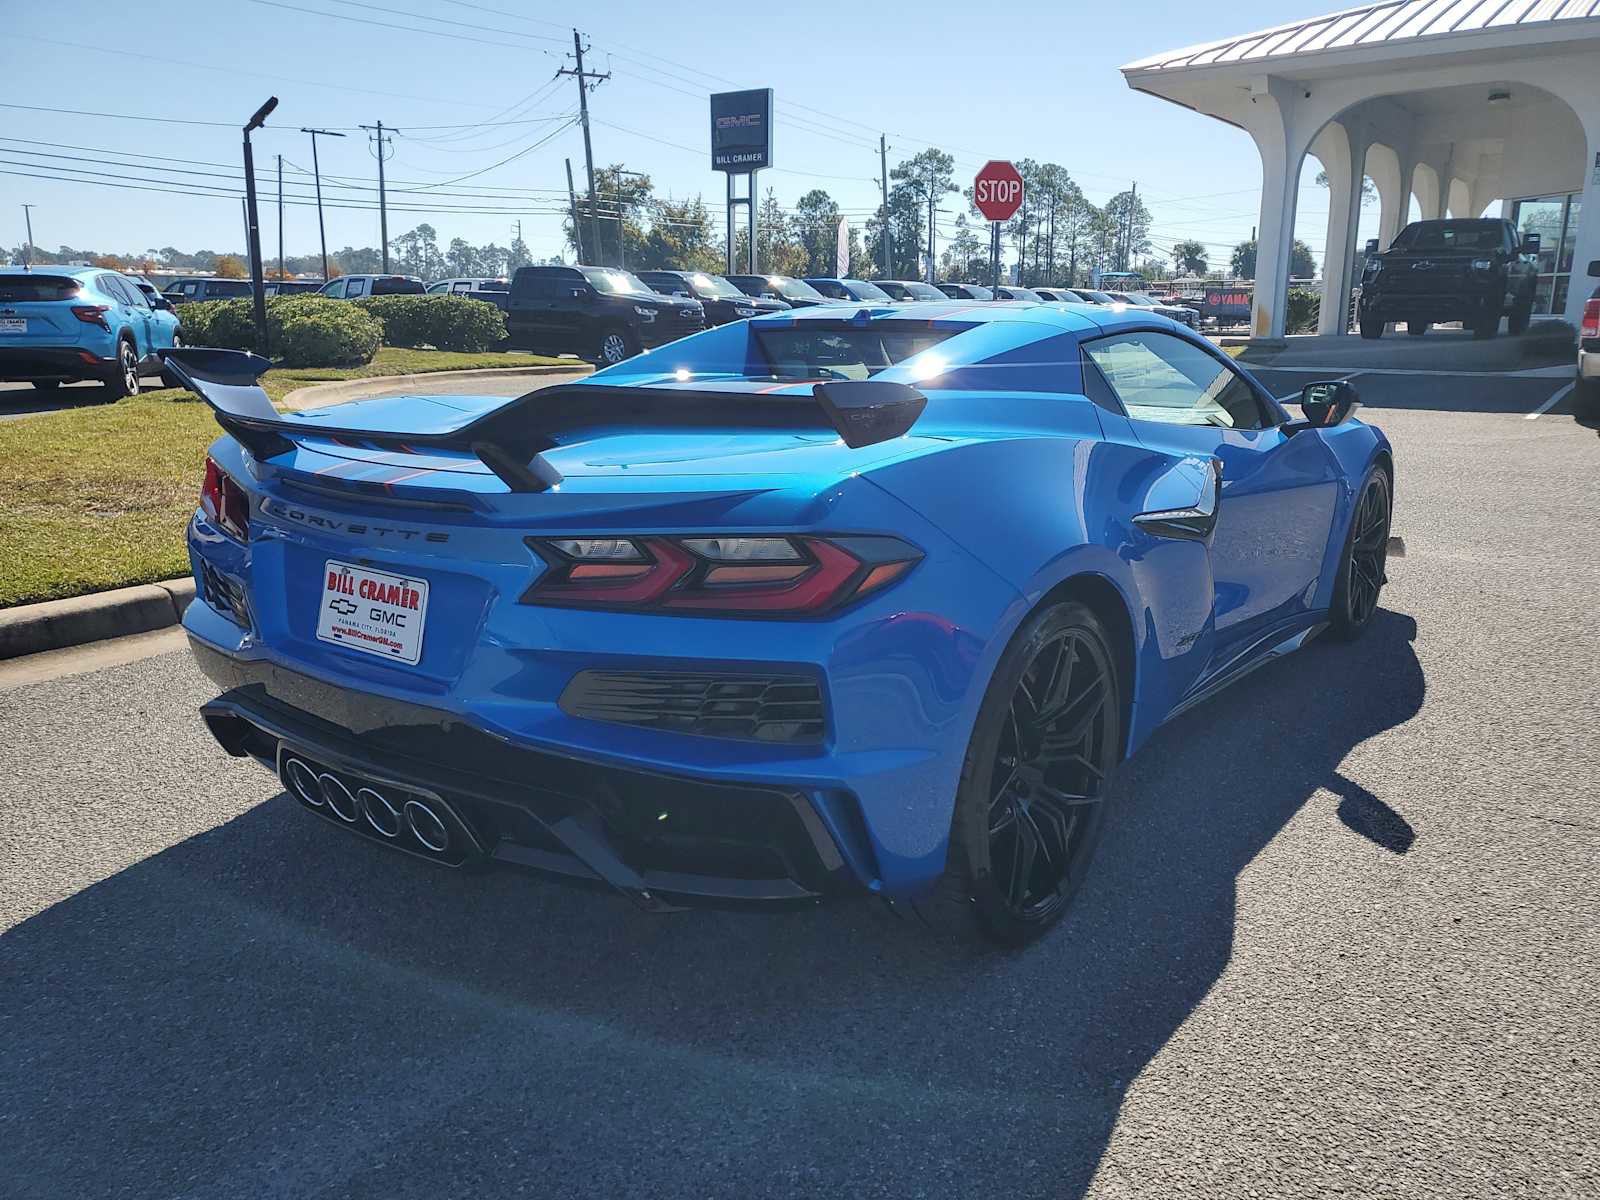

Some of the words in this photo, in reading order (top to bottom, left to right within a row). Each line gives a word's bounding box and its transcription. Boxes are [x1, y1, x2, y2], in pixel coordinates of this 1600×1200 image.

[716, 156, 731, 164] BILL
[732, 153, 762, 163] CRAMER
[977, 179, 1020, 203] STOP
[273, 504, 450, 543] CORVETTE
[328, 572, 355, 596] BILL
[358, 578, 420, 611] CRAMER
[369, 608, 407, 628] GMC
